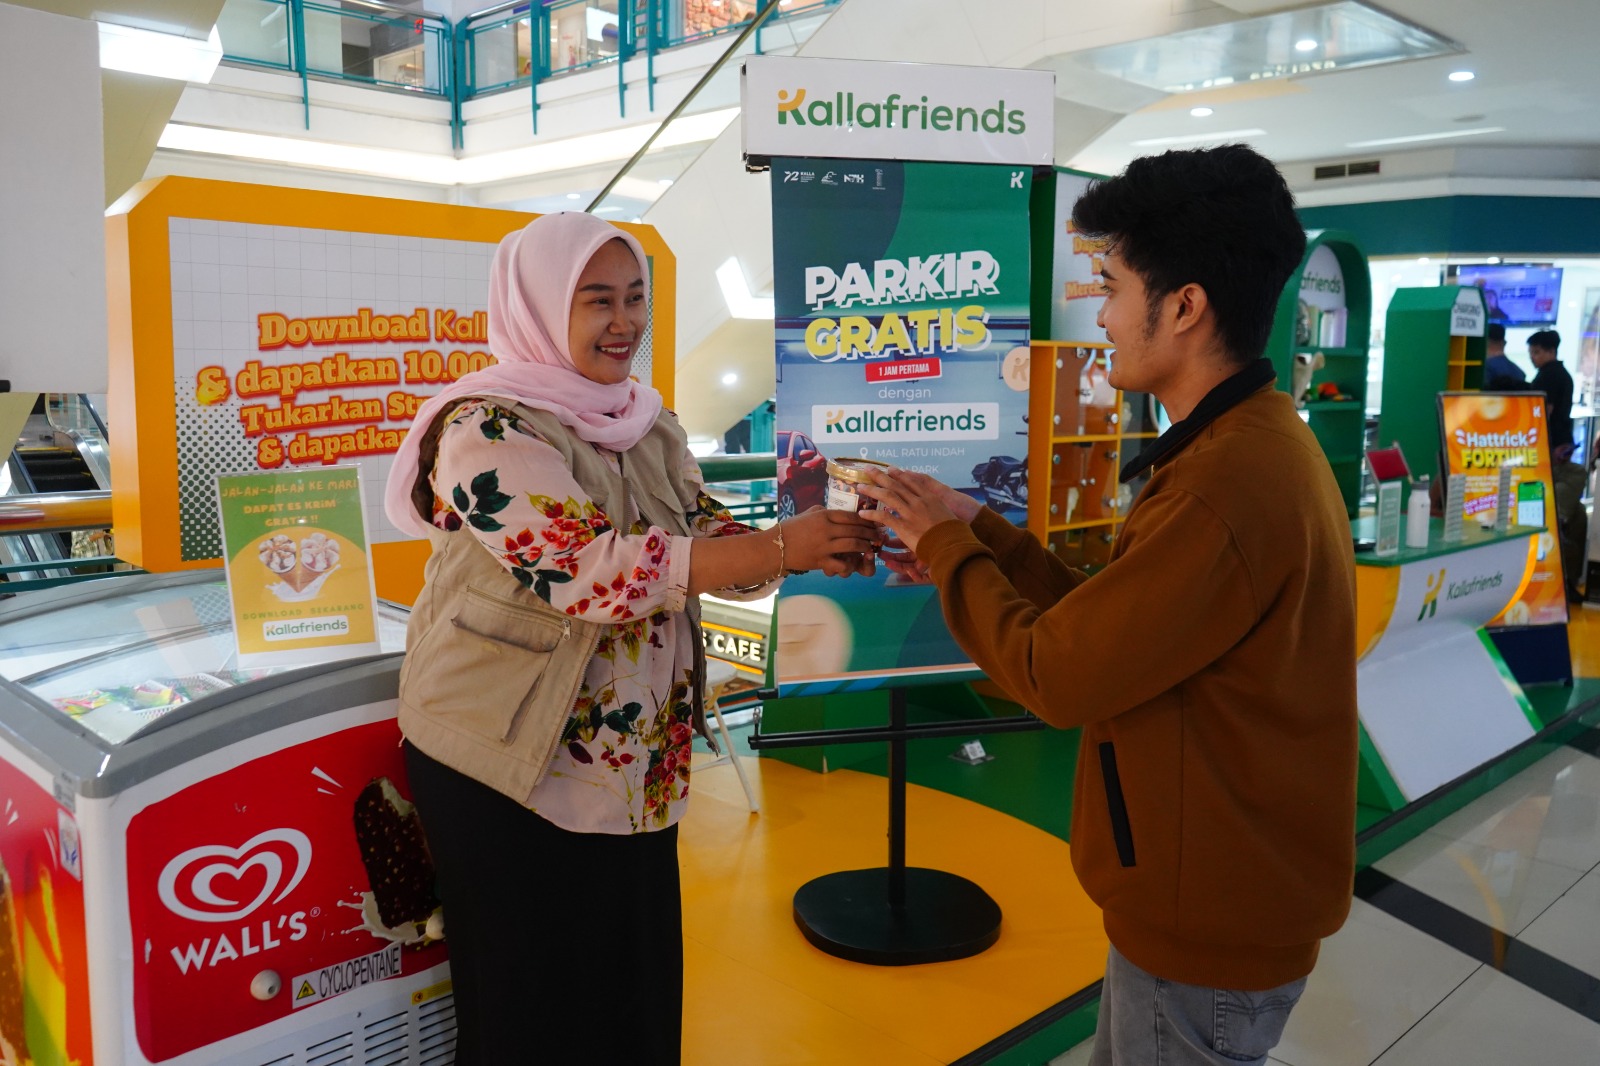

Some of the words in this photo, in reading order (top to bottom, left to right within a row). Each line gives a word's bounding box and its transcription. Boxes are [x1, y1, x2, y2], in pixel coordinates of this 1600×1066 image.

[777, 88, 1026, 135] Kallafriends
[805, 250, 1000, 311] PARKIR
[258, 309, 429, 349] Download
[435, 309, 488, 342] Kall
[804, 304, 992, 363] GRATIS
[197, 367, 230, 405] &
[237, 353, 400, 400] dapatkan
[879, 366, 883, 377] 1
[884, 365, 898, 376] JAM
[899, 363, 930, 375] PERTAMA
[878, 386, 932, 401] dengan
[241, 397, 384, 435] Tukarkan
[826, 408, 986, 434] Kallafriends
[258, 437, 285, 468] &
[876, 449, 898, 458] MAL
[901, 448, 928, 457] RATU
[931, 447, 965, 457] INDAH
[1466, 431, 1529, 448] Hattrick
[911, 465, 939, 474] PARK
[1461, 448, 1538, 469] FORTUNE
[222, 483, 305, 497] JALAN-JALAN
[309, 481, 323, 490] KE
[243, 505, 283, 514] DAPAT
[287, 503, 301, 511] ES
[1446, 571, 1503, 601] Kallafriends
[242, 608, 302, 620] DOWNLOAD
[310, 603, 364, 614] SEKARANG
[265, 619, 348, 637] Kallafriends
[713, 634, 761, 661] CAFE
[170, 911, 308, 976] WALL'S
[319, 946, 400, 999] CYCLOPENTANE
